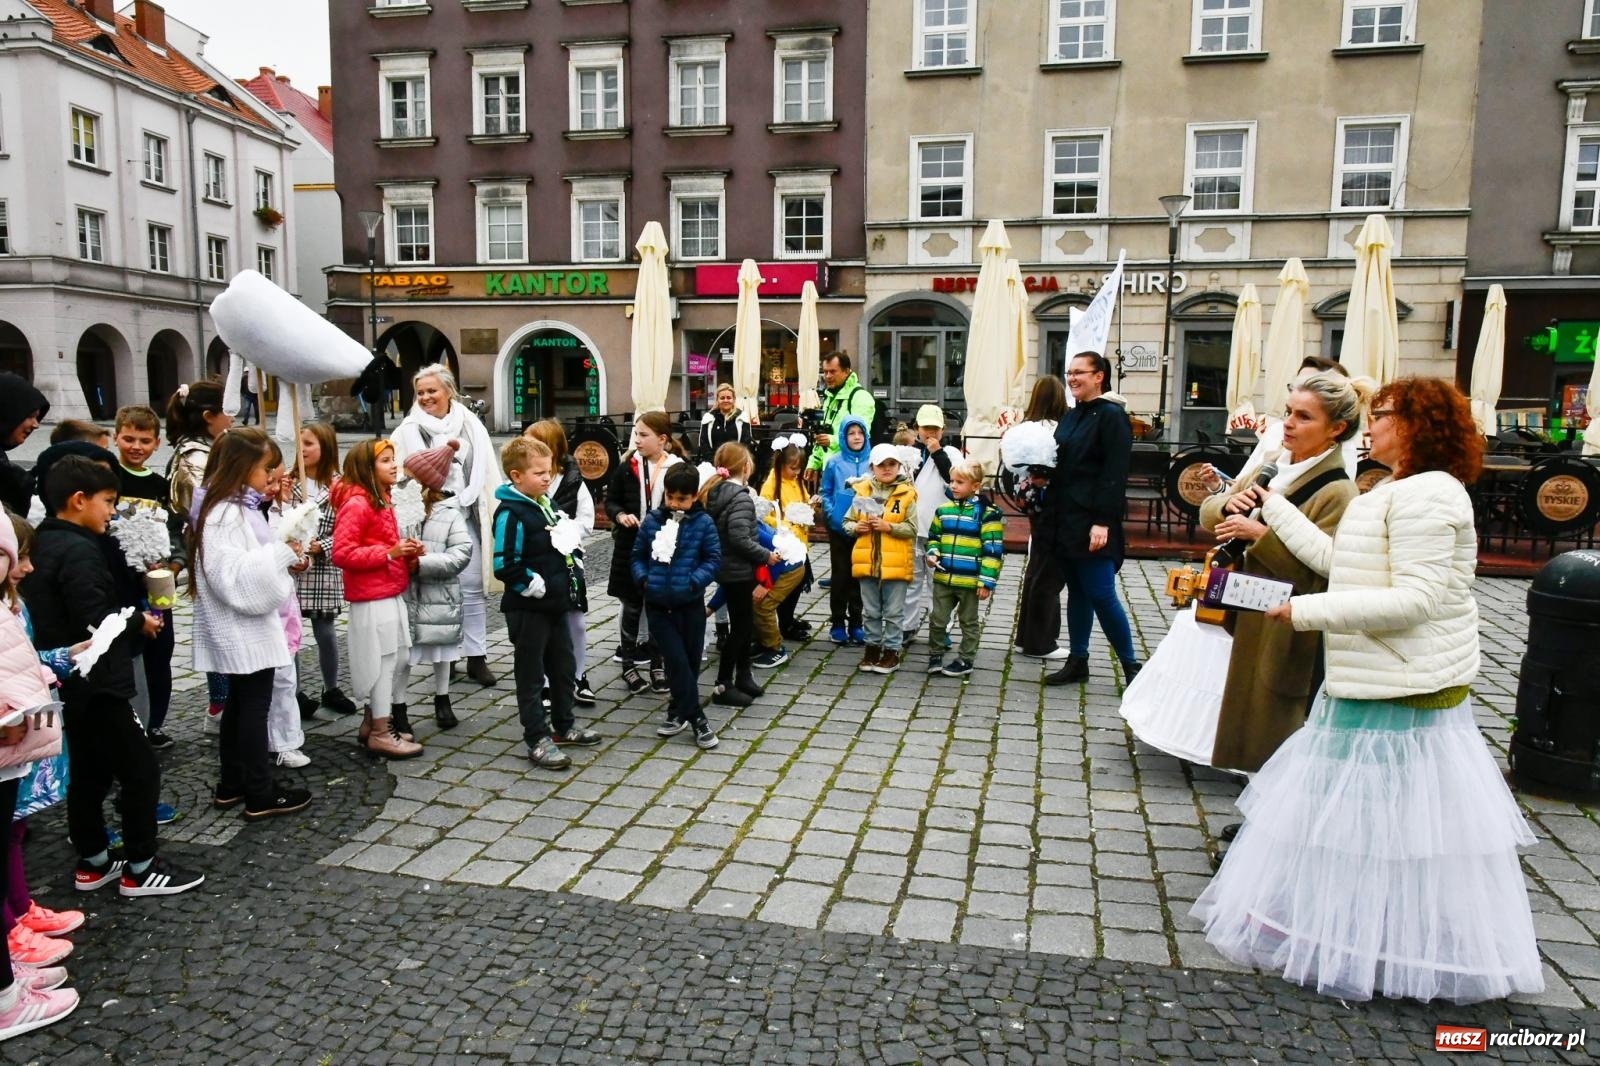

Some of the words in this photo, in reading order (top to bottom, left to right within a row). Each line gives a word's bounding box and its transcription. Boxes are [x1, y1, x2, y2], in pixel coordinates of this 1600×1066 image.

[366, 274, 448, 287] TABAC
[485, 271, 609, 295] KANTOR
[533, 338, 577, 347] KANTOR
[515, 358, 523, 414] KANTOR
[891, 499, 901, 513] A
[1543, 495, 1580, 506] TYSKIE
